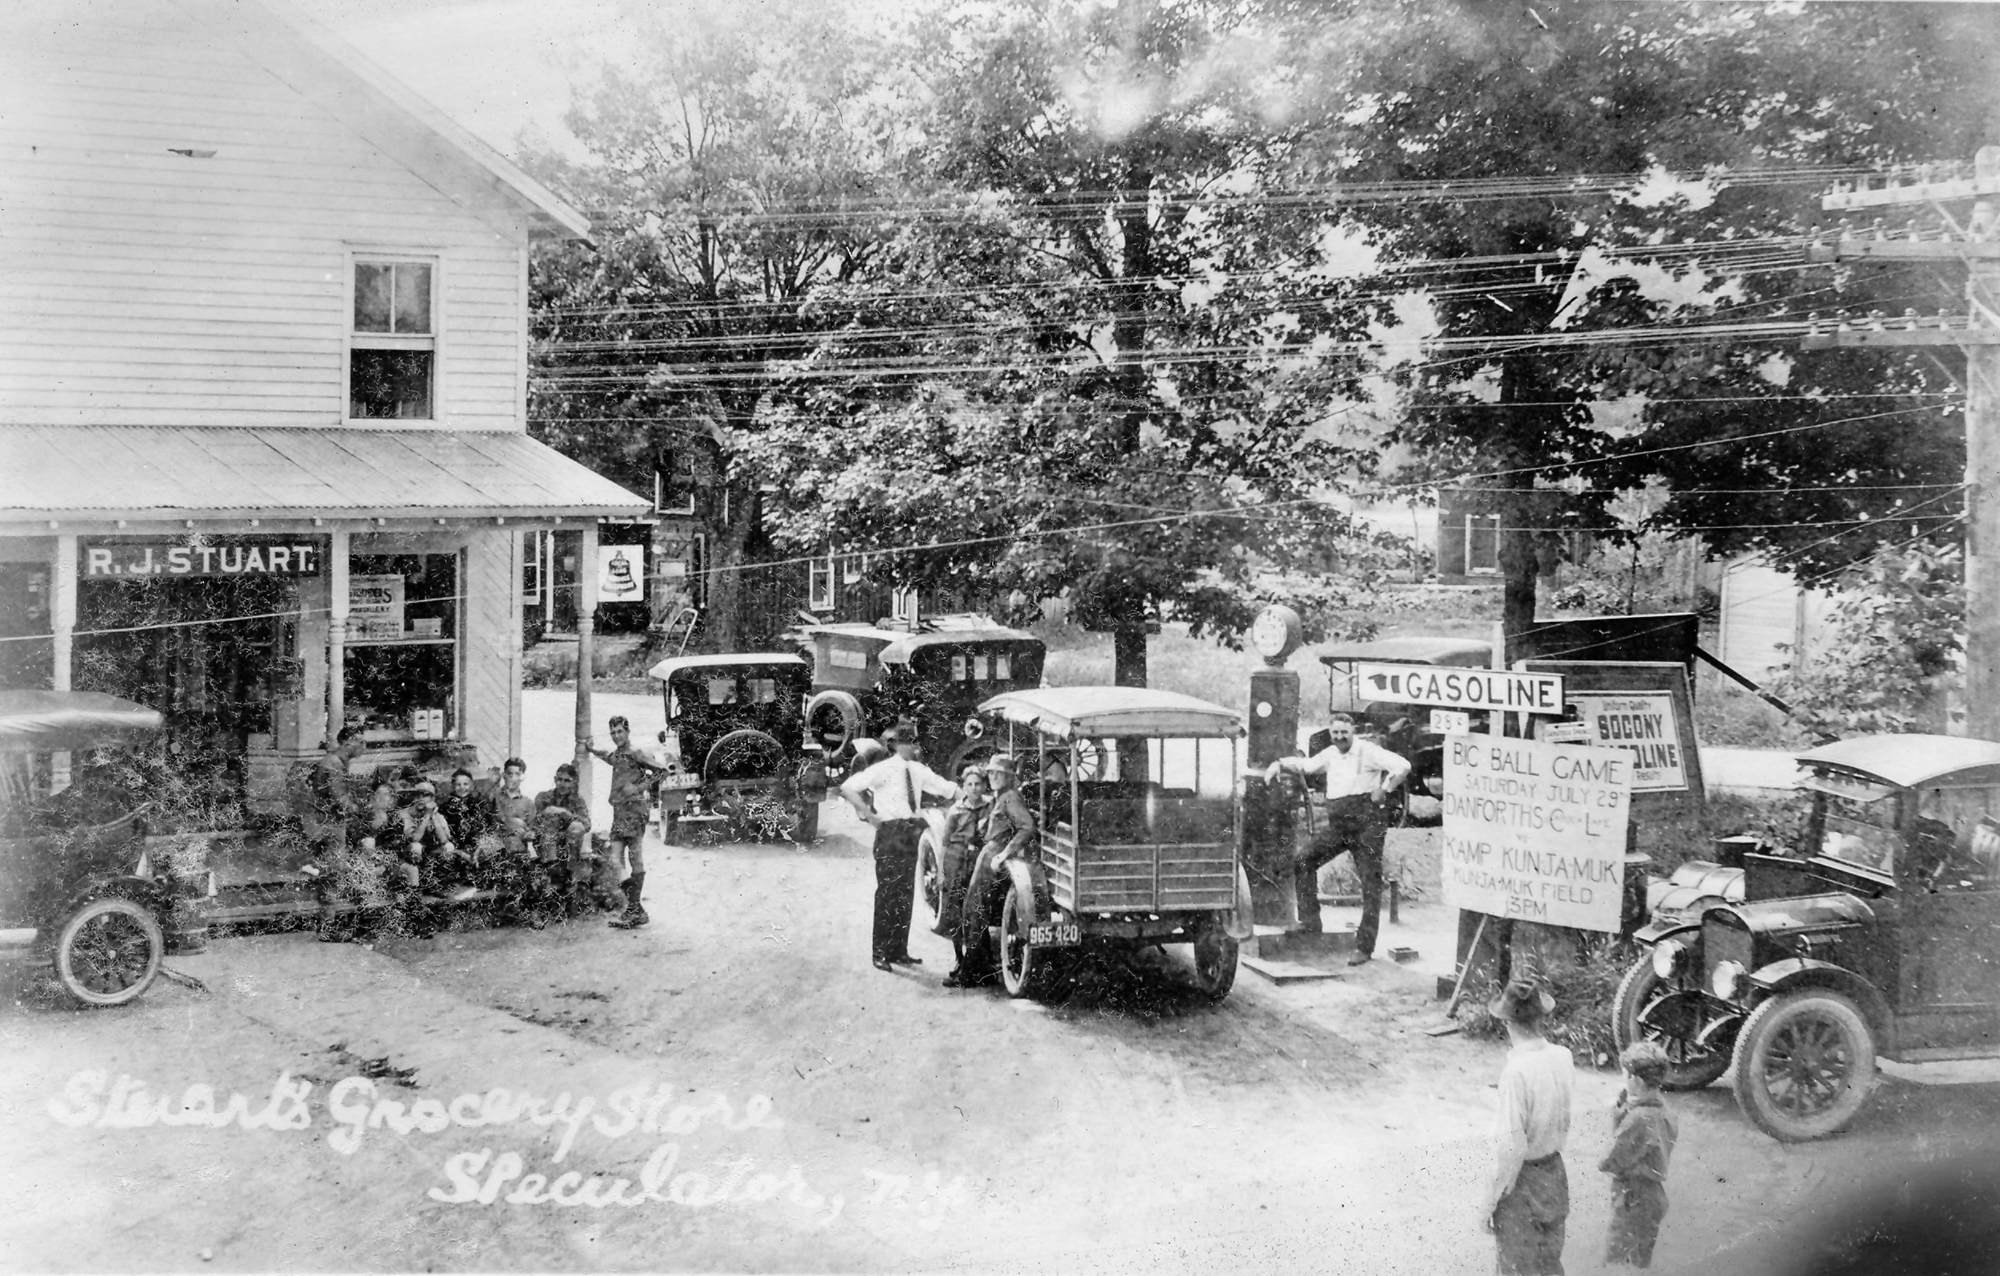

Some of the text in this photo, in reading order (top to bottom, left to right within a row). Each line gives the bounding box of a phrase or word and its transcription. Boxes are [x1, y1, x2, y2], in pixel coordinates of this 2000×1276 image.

[1406, 672, 1555, 707] GASOLINE
[1597, 714, 1664, 740] SOCONY
[1491, 748, 1540, 777] BALL
[1551, 755, 1623, 785] GAME
[1465, 774, 1537, 799] SATURDAY
[1546, 785, 1591, 805] JULY
[1445, 793, 1544, 829] DANFORTHS
[1445, 836, 1492, 865] KAMP
[1541, 882, 1593, 905] FIELD
[1029, 925, 1079, 944] 965 420
